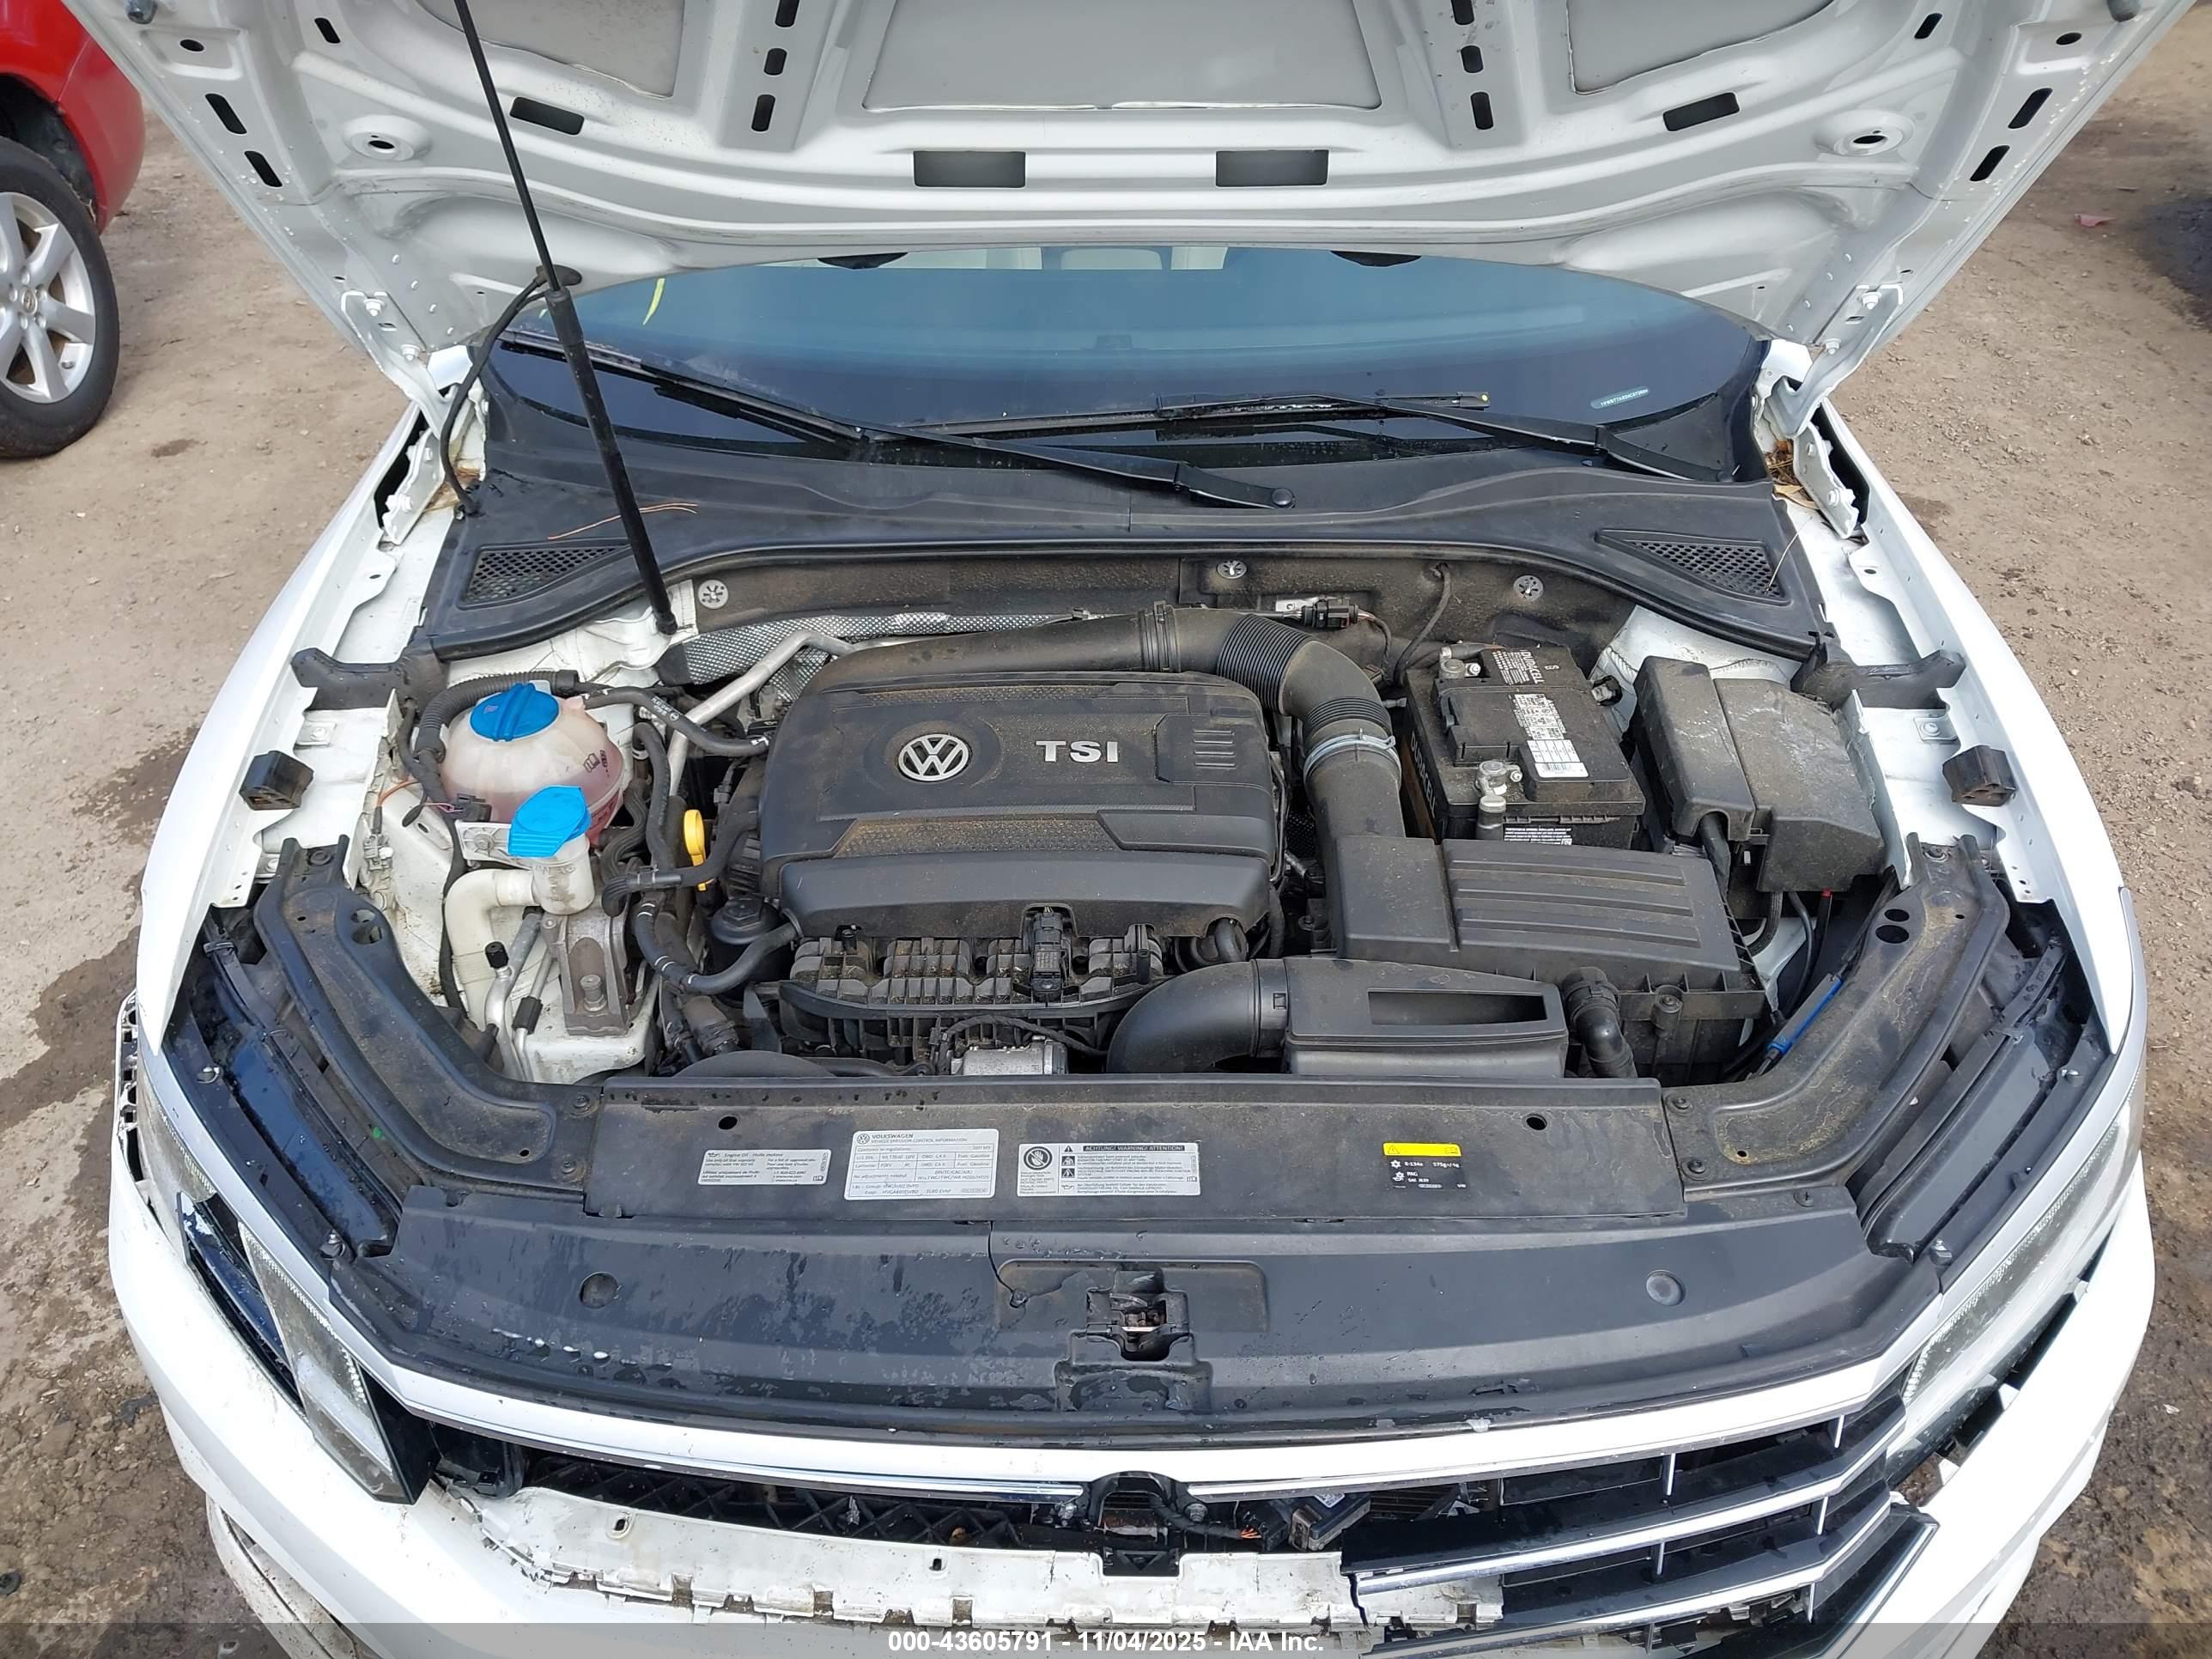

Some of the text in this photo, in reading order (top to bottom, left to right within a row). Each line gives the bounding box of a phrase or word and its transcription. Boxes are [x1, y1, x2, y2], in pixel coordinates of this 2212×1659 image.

[1521, 651, 1545, 684] DURACELL
[899, 734, 969, 781] VW
[1036, 741, 1119, 763] TSI
[1411, 730, 1436, 818] DURACELL
